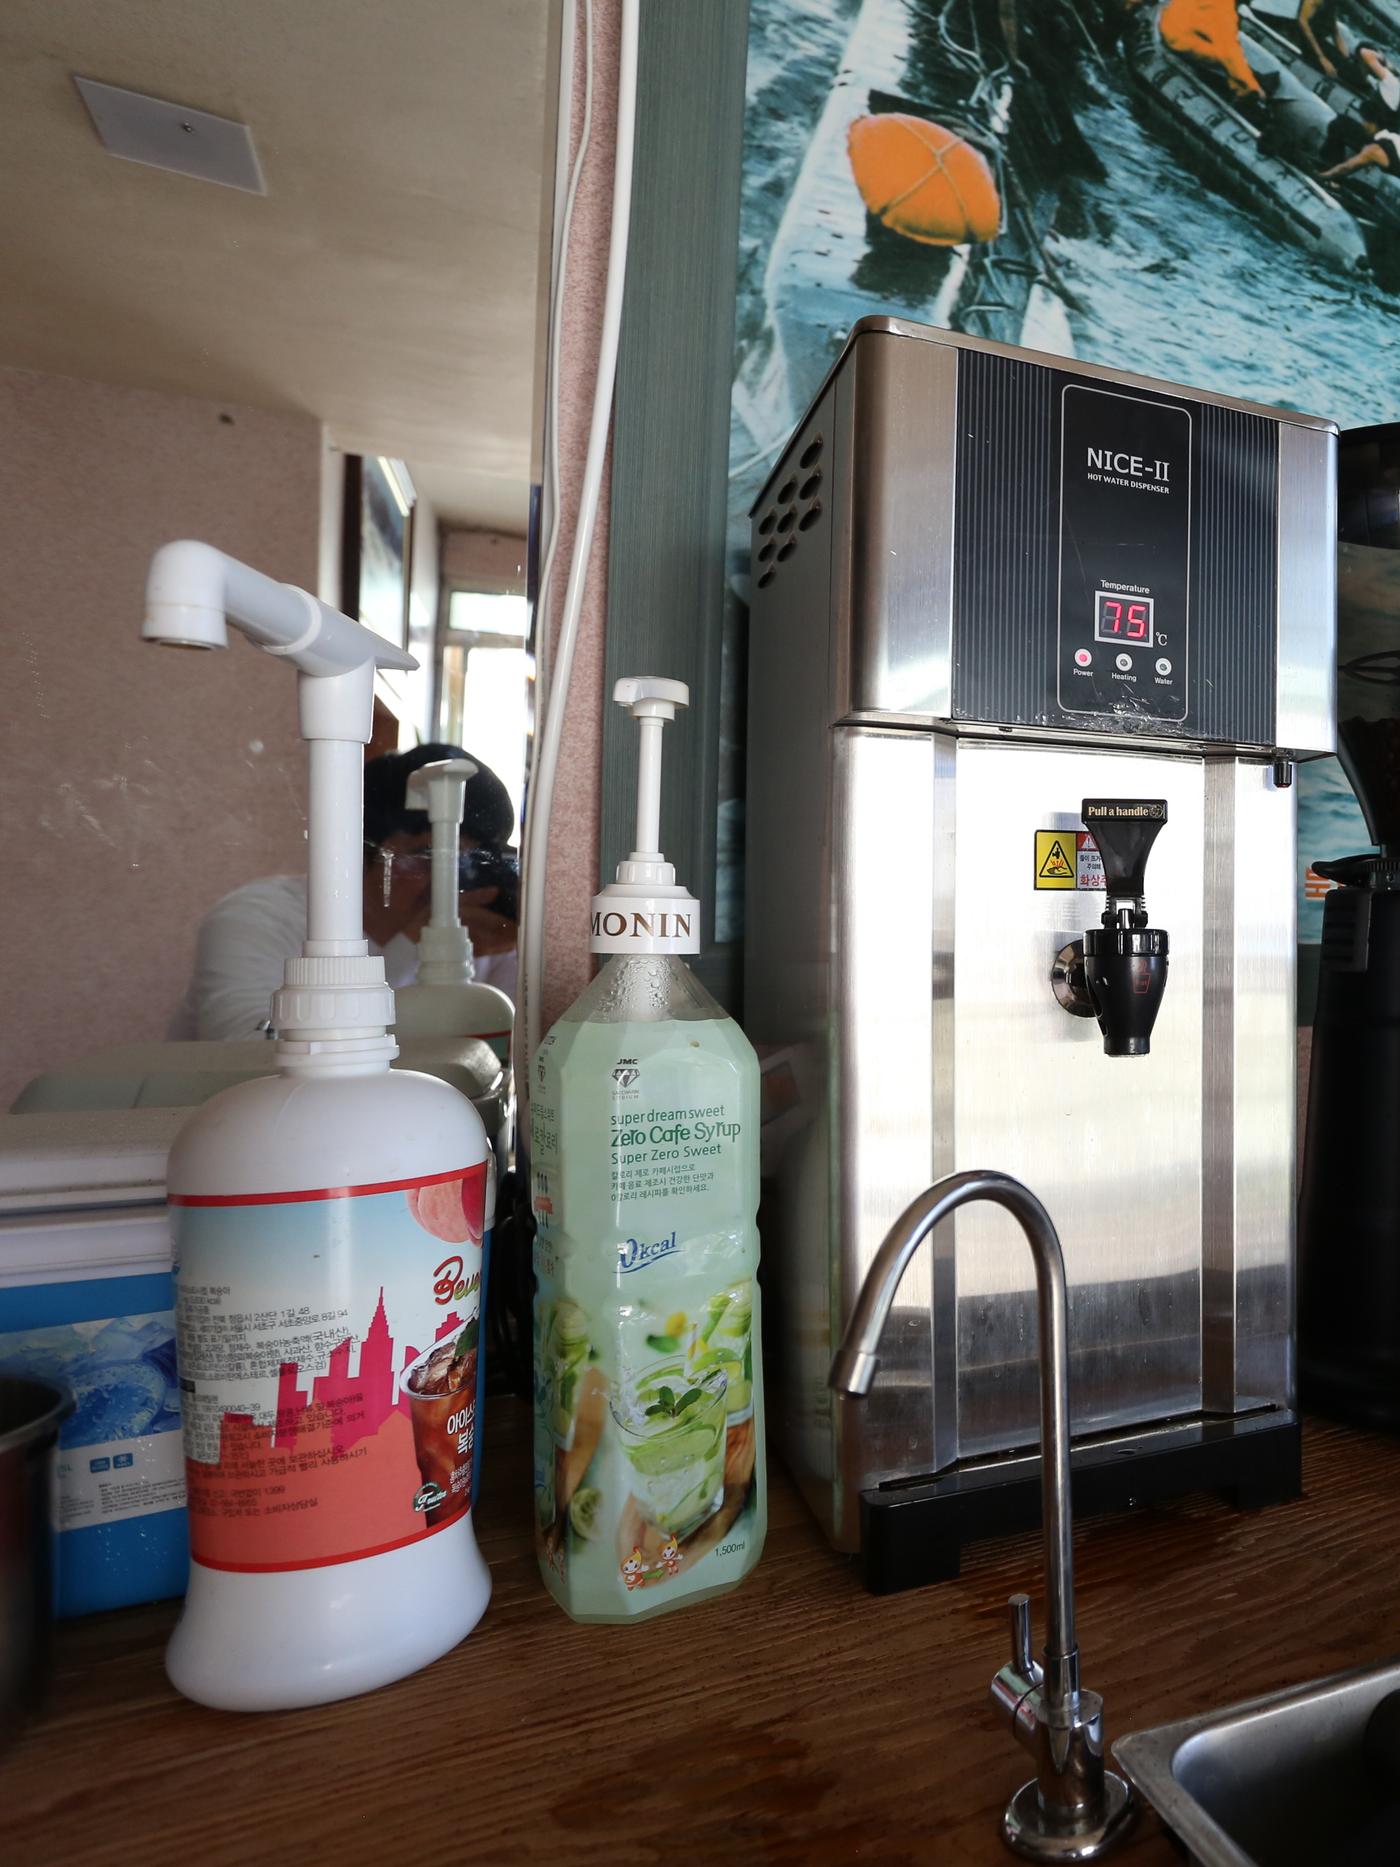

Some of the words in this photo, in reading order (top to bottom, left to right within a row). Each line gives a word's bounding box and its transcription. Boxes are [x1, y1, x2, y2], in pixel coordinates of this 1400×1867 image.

[1087, 447, 1170, 482] NICE-II
[1087, 472, 1102, 482] HOT
[1103, 475, 1129, 487] WATER
[1130, 480, 1170, 494] DISPENSER
[1100, 579, 1150, 594] Temperature
[1105, 601, 1146, 638] 75
[1073, 668, 1094, 677] Power
[1111, 672, 1138, 682] Heating
[1154, 677, 1173, 686] Water
[1088, 806, 1107, 816] Pull
[1116, 806, 1149, 817] handle
[611, 1113, 646, 1126] super
[647, 1108, 688, 1122] dream
[689, 1105, 726, 1119] sweet
[611, 1128, 646, 1147] Zero
[649, 1123, 691, 1145] Cafe
[694, 1120, 742, 1143] Syrup
[611, 1152, 648, 1165] Super
[651, 1149, 680, 1161] Zero
[683, 1143, 723, 1158] Sweet
[715, 1540, 746, 1557] 1,500ml
